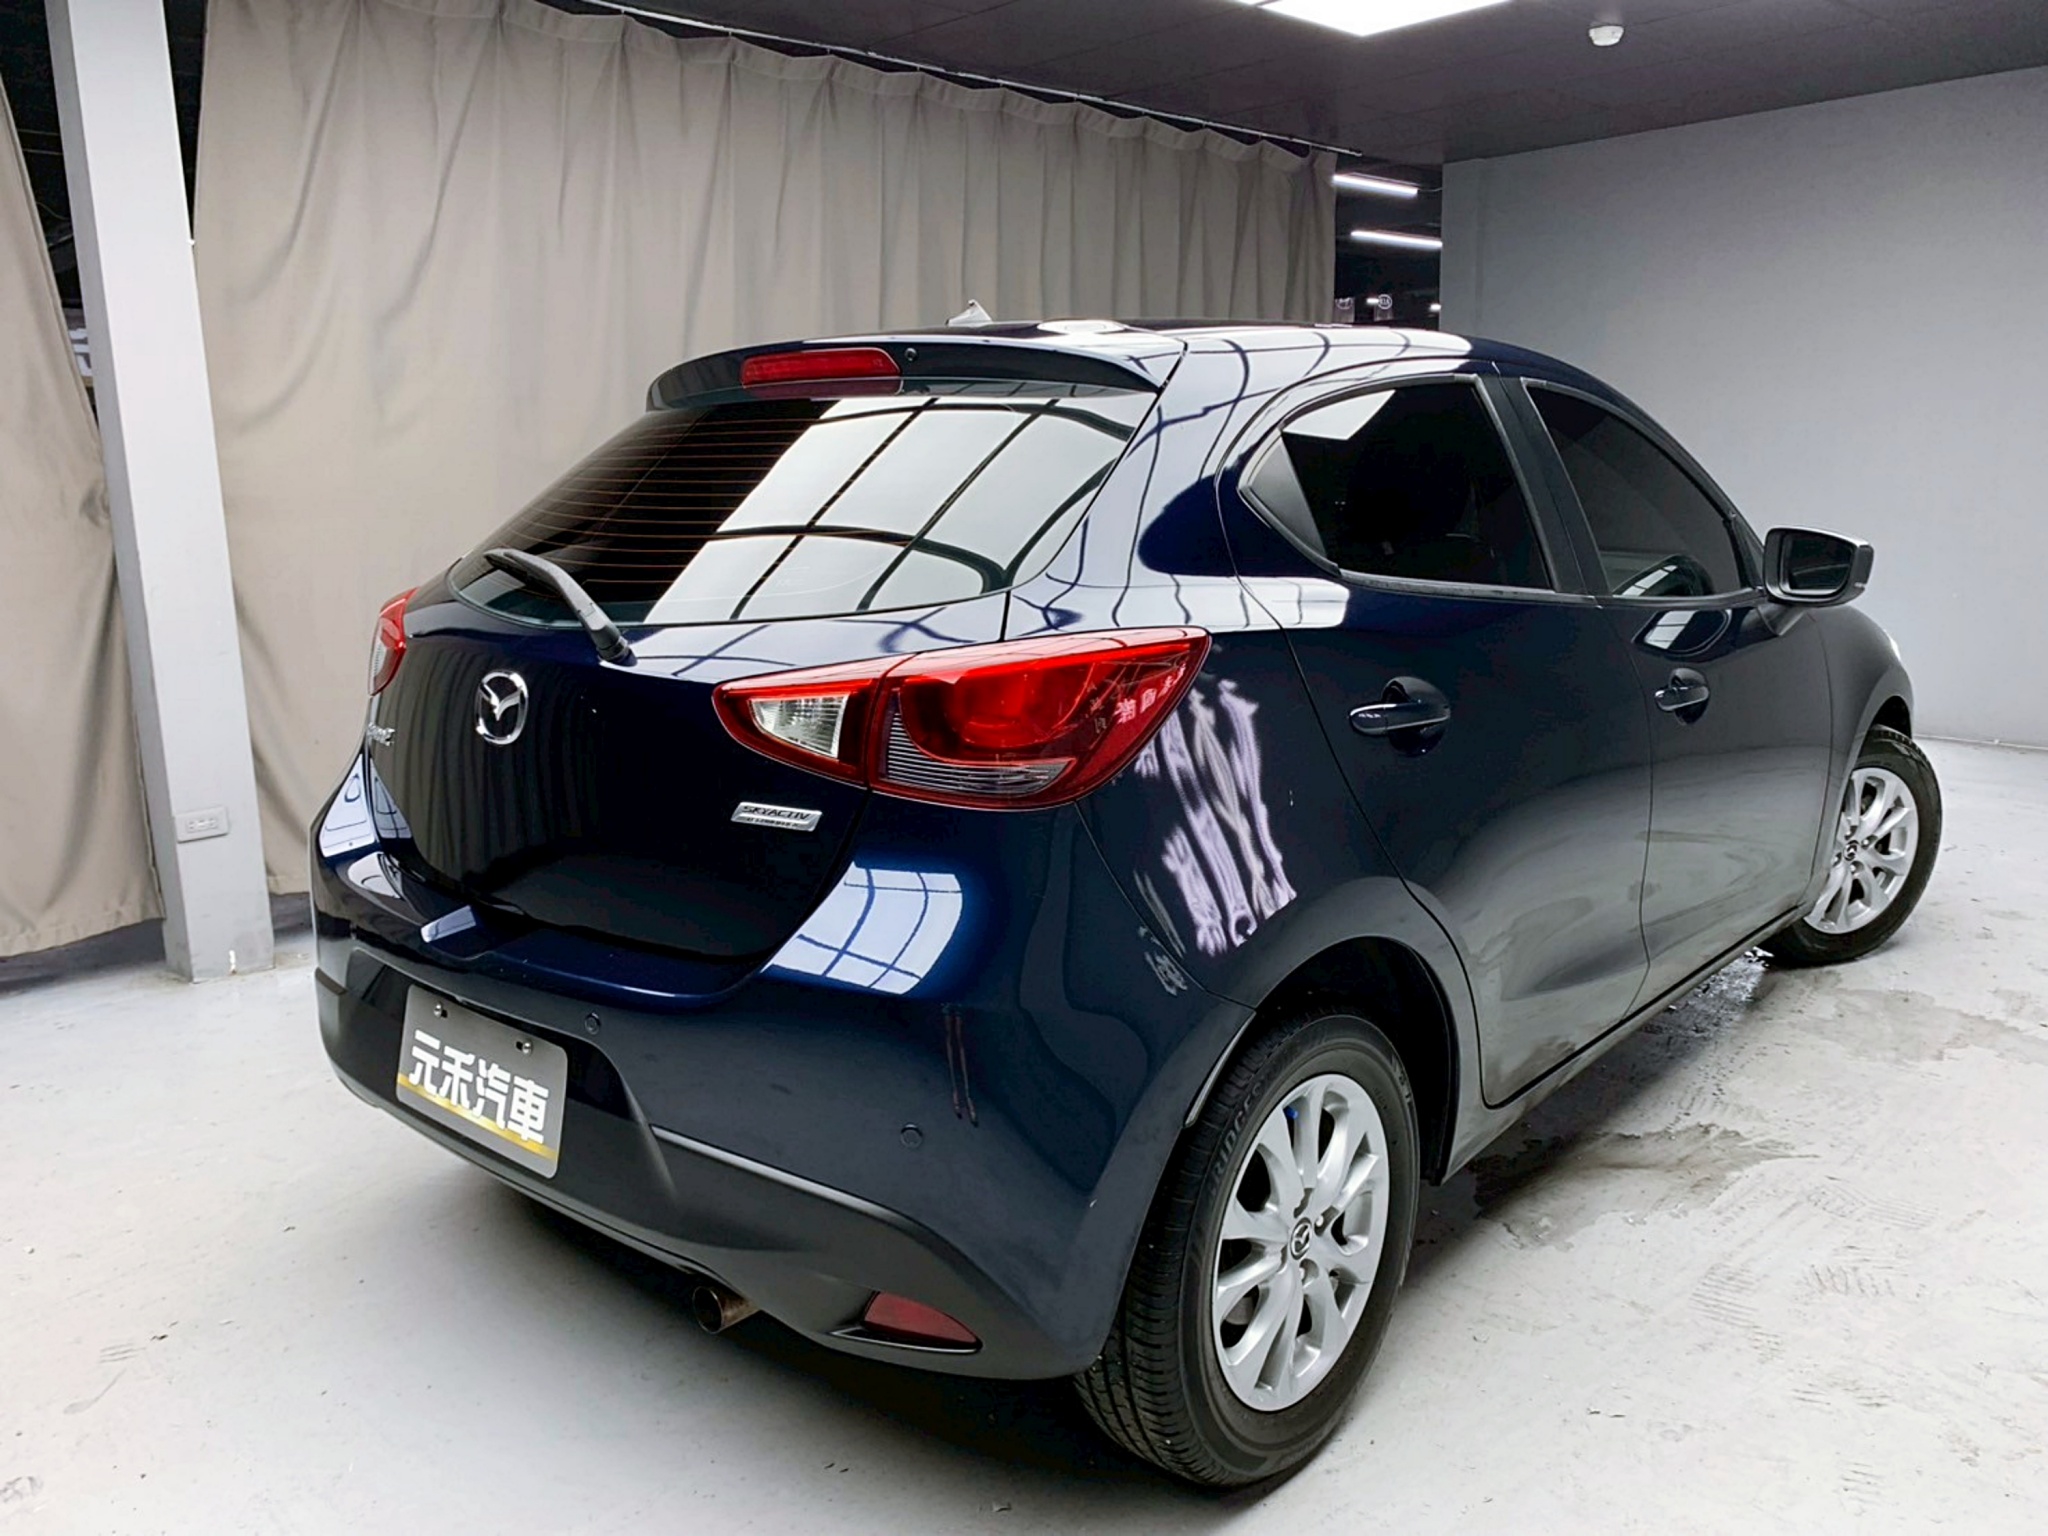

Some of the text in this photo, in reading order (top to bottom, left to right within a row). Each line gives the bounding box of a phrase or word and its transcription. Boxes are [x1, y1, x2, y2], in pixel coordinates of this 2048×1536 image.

[741, 804, 811, 820] SKYACTIV
[408, 1029, 549, 1144] 元禾汽車
